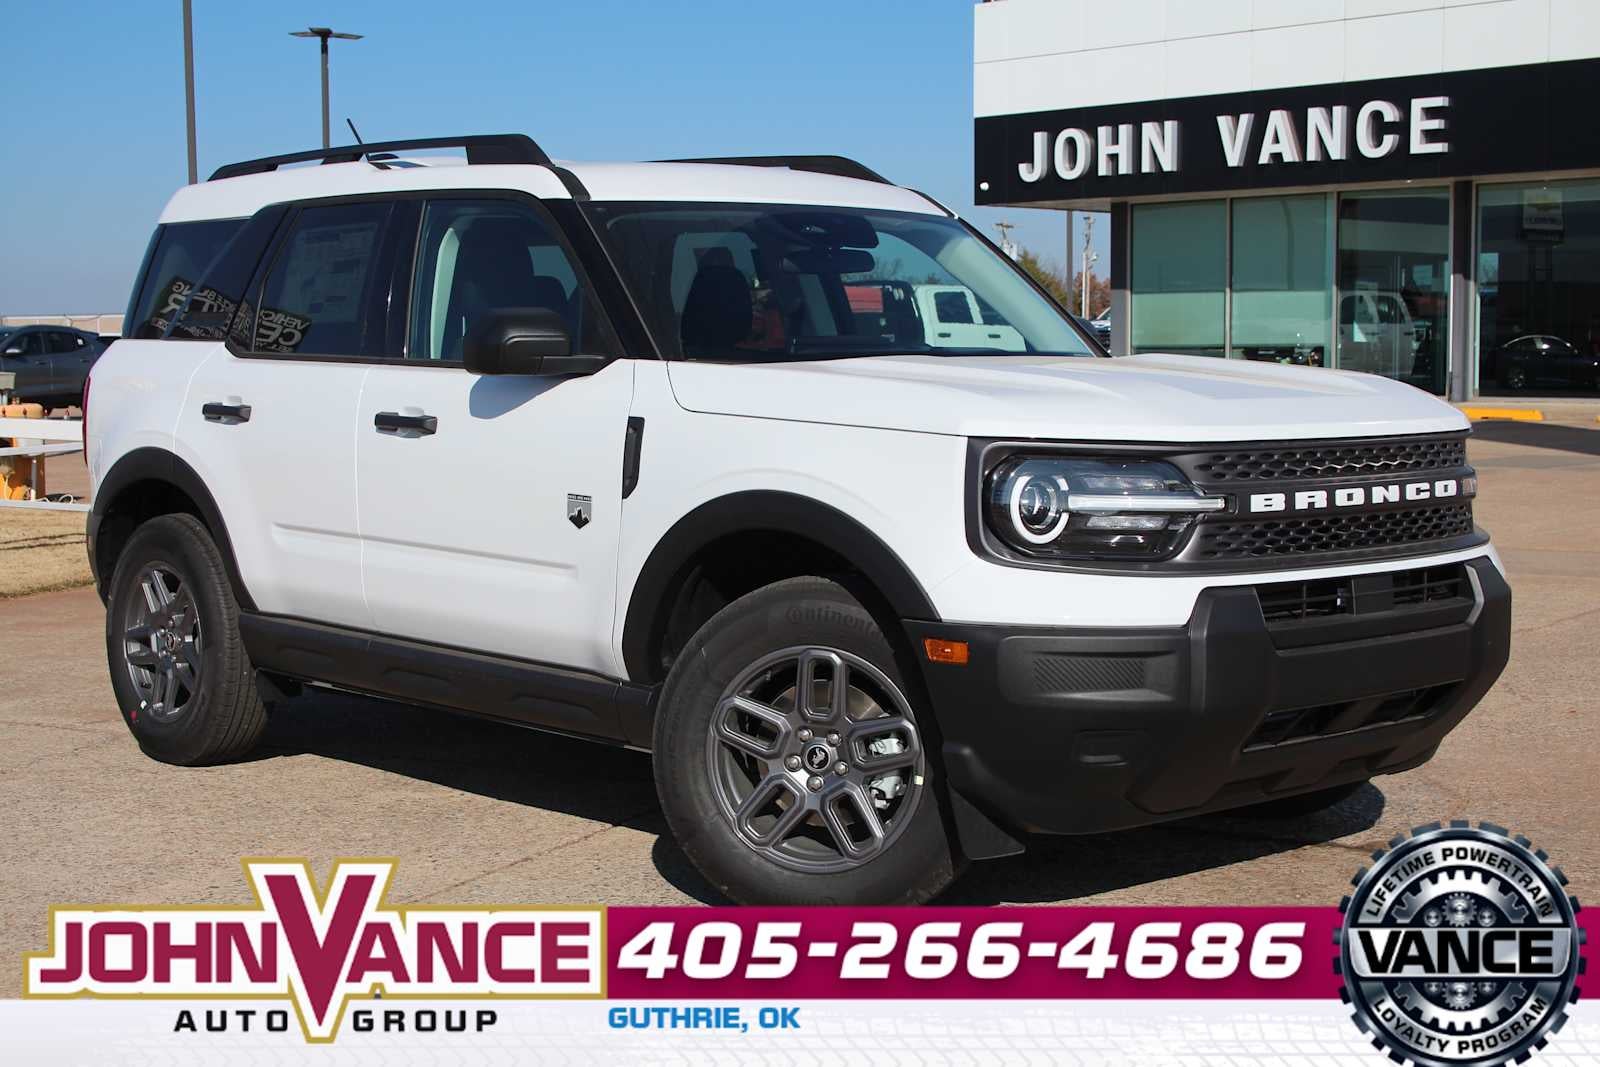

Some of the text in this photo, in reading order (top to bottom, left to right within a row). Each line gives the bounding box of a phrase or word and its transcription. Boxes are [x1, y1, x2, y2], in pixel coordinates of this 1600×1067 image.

[1018, 96, 1449, 183] JOHN VANCE
[1250, 479, 1457, 512] BRONCO
